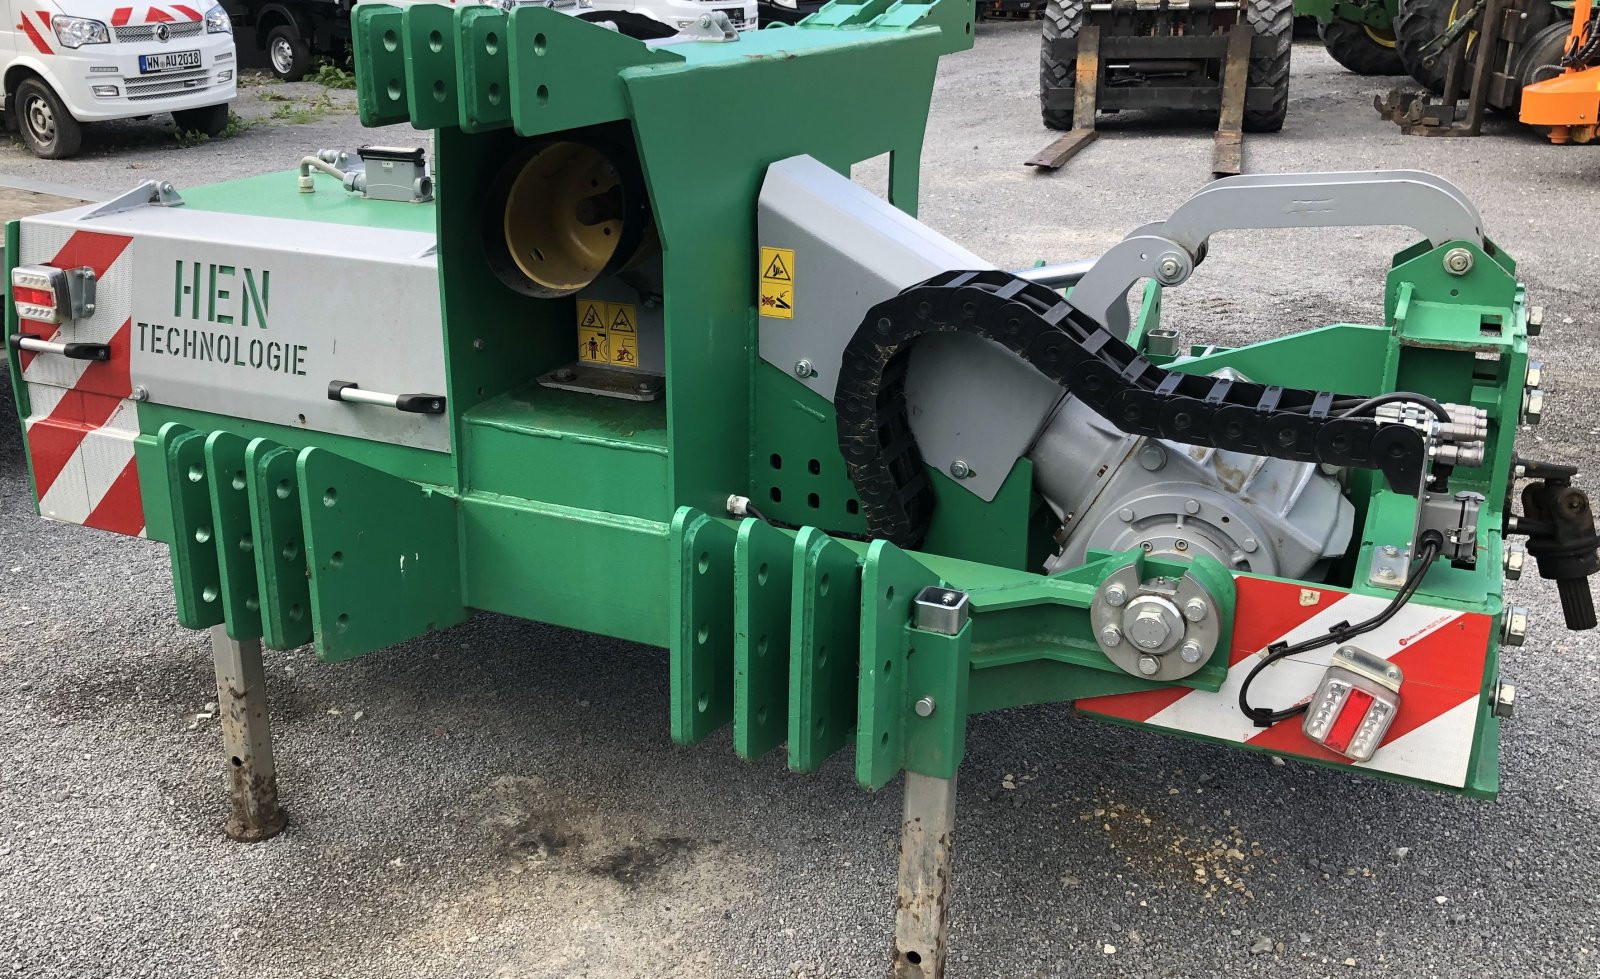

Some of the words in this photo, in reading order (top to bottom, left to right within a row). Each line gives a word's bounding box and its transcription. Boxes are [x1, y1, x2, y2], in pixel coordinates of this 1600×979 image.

[147, 57, 159, 69] WN
[174, 259, 270, 329] HEN
[137, 322, 308, 376] TECHNOLOGIE
